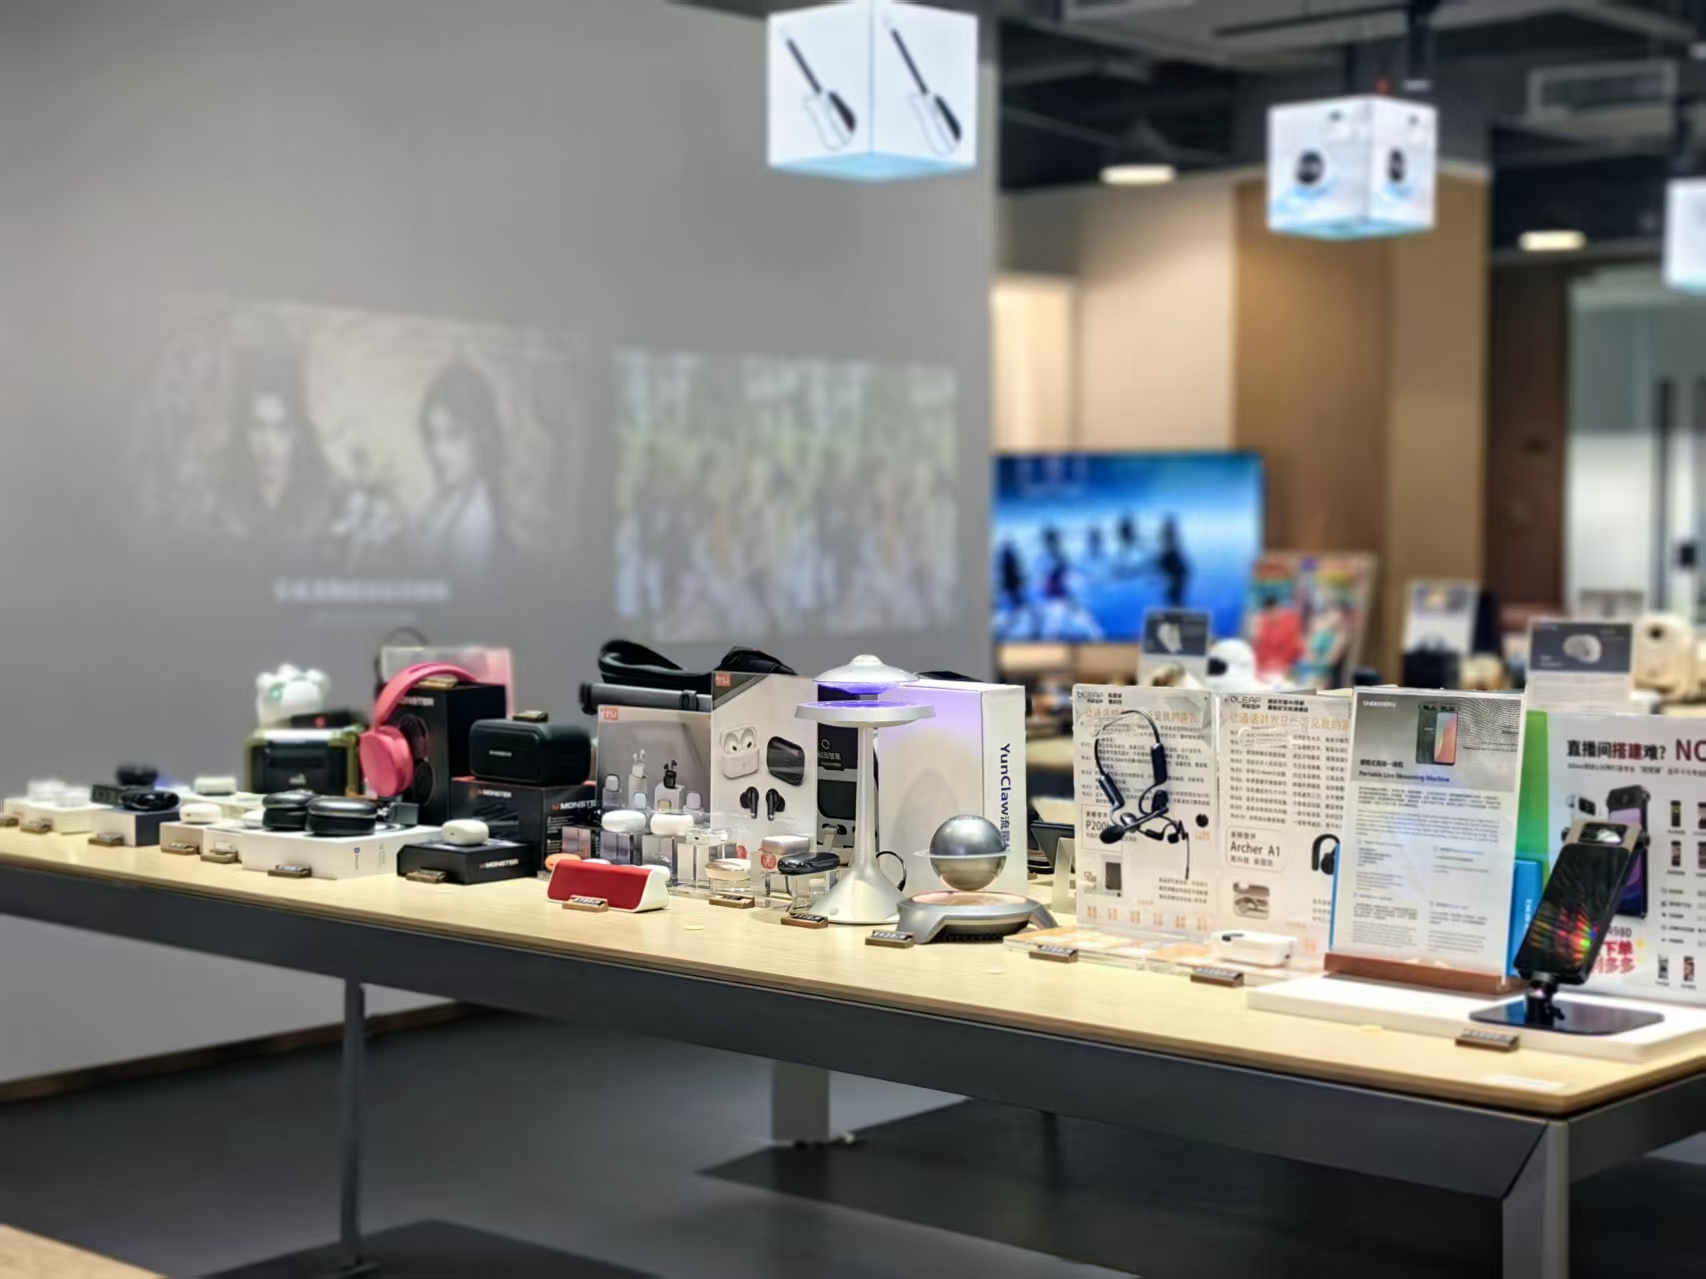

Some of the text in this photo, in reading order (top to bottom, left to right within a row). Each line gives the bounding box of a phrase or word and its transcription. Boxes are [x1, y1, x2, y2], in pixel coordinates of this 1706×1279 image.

[1000, 742, 1011, 816] YunClaw
[1230, 840, 1280, 857] Archer A1
